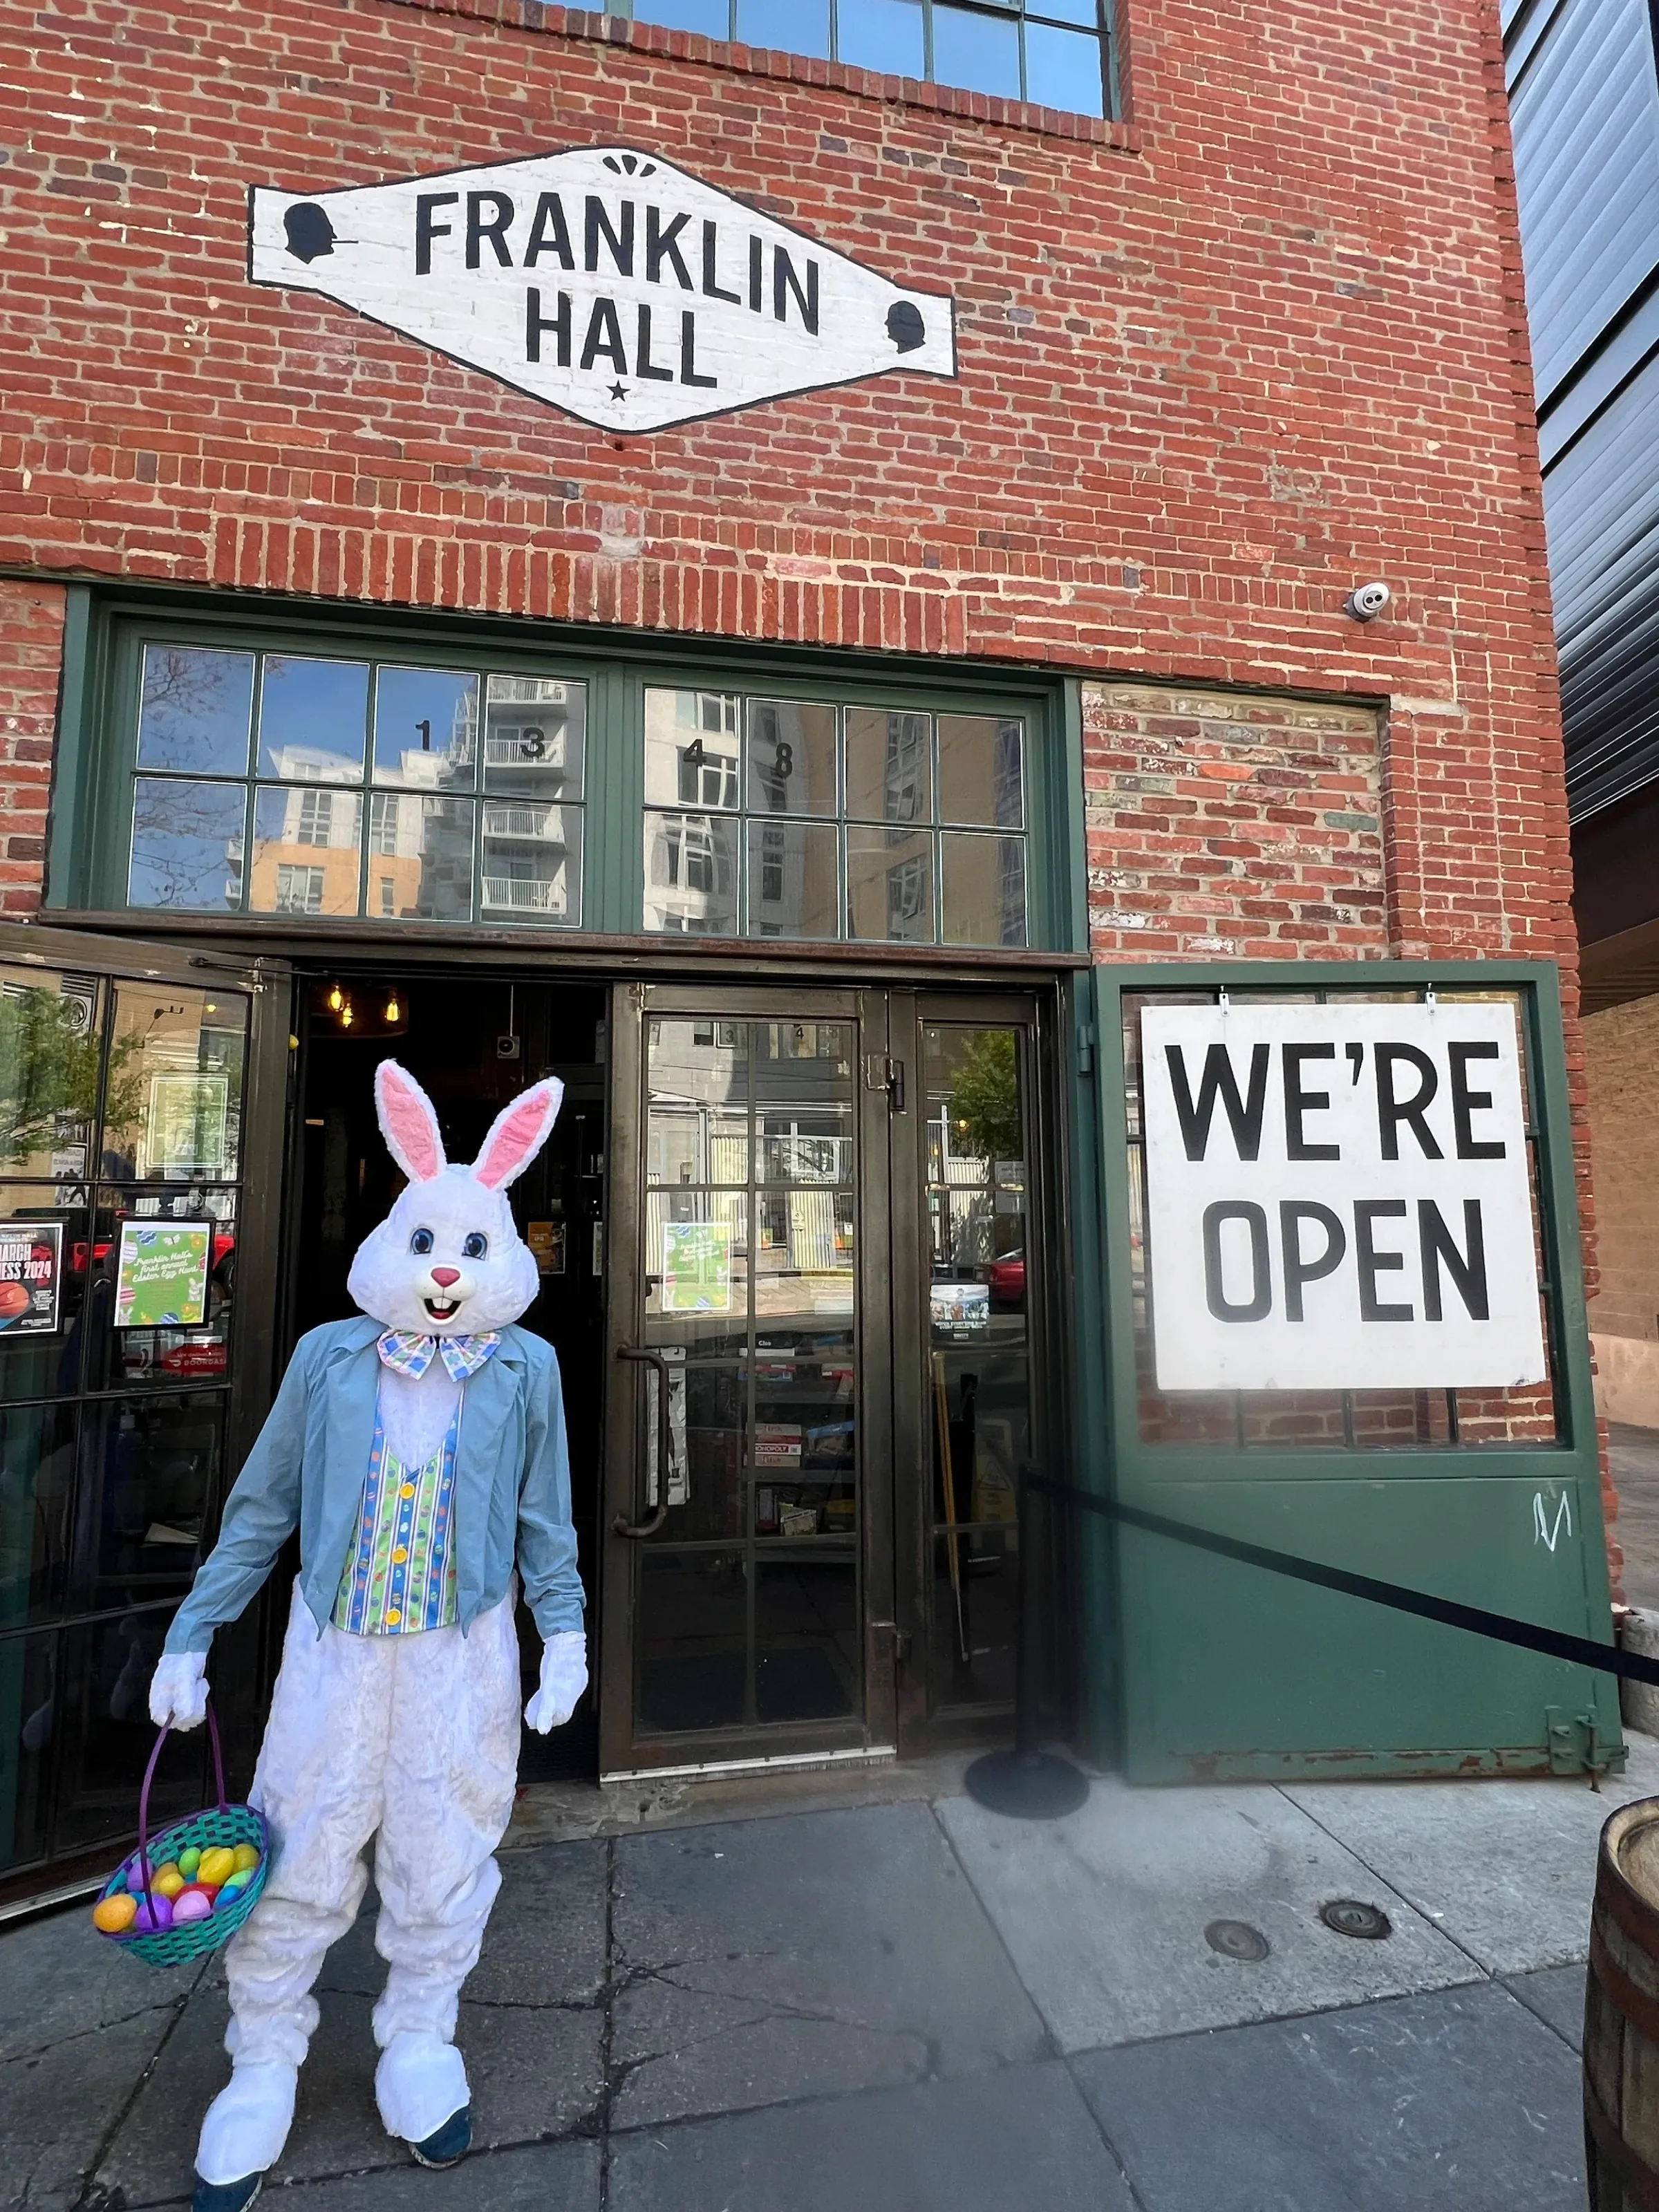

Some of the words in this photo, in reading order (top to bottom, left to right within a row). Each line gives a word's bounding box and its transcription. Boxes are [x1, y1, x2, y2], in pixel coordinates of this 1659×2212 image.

[415, 189, 820, 337] FRANKLIN
[526, 288, 718, 388] HALL
[1164, 1041, 1506, 1161] WE'RE
[24, 1260, 52, 1280] 2024
[132, 1273, 160, 1283] Easter
[160, 1268, 178, 1280] Egg
[178, 1264, 198, 1275] Hunt
[133, 1254, 169, 1266] Franklin
[140, 1264, 160, 1276] first
[1202, 1199, 1490, 1323] OPEN
